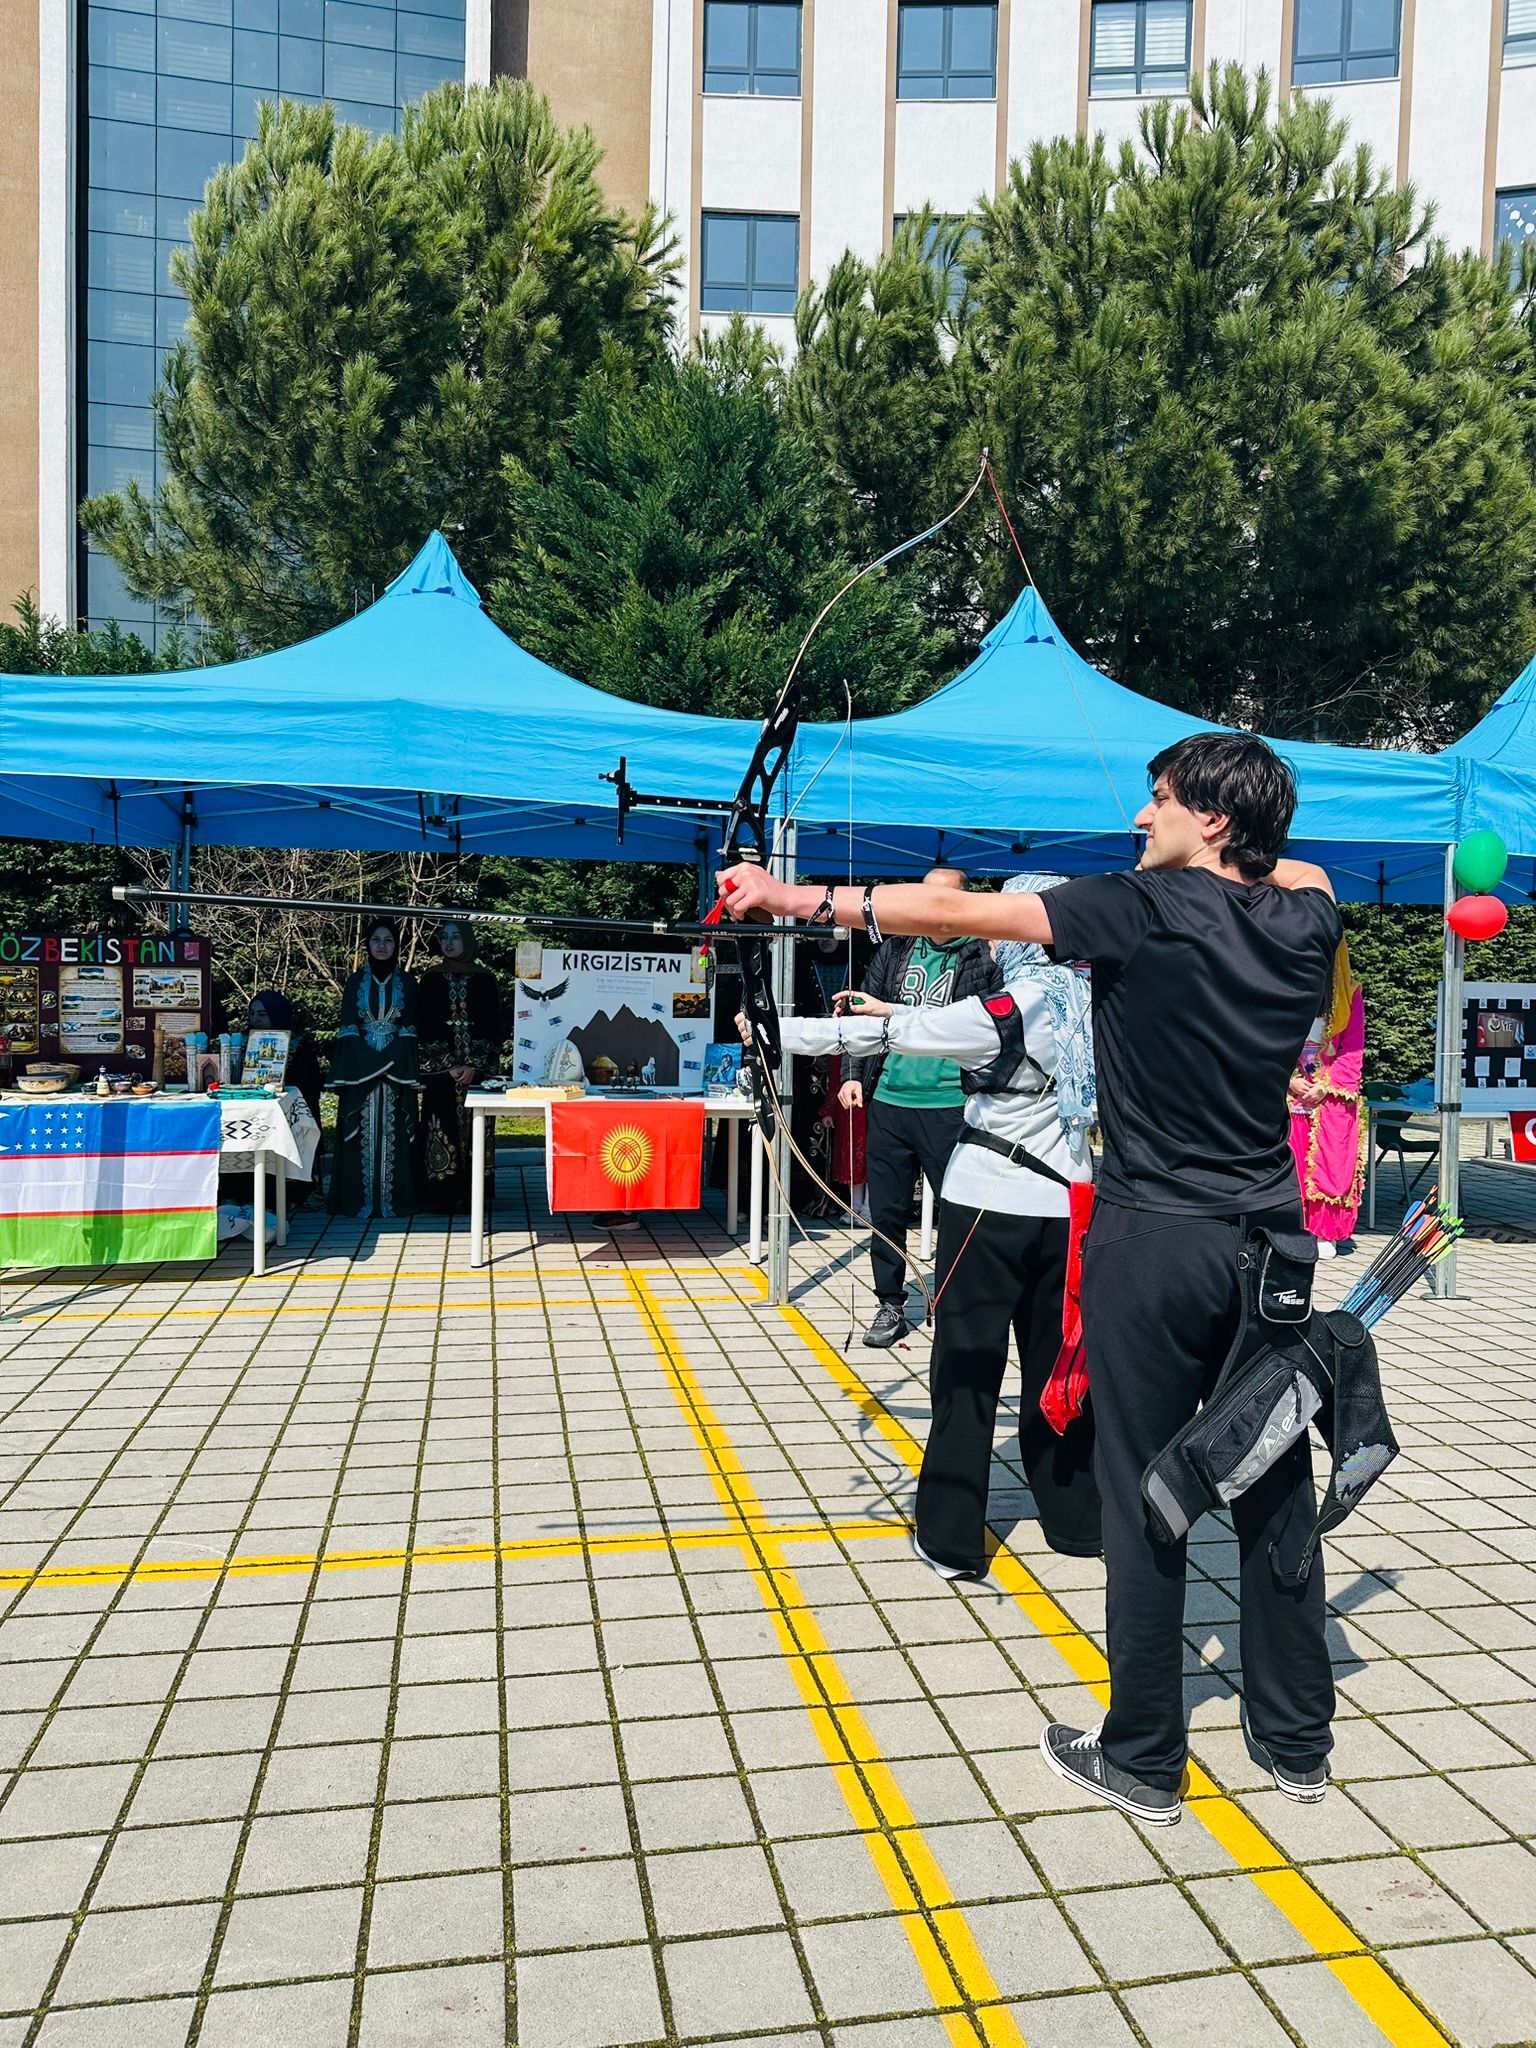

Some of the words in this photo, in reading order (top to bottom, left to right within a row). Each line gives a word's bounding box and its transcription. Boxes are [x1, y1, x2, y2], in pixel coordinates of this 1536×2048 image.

[0, 932, 176, 963] ÖZBEKİSTAN
[562, 953, 682, 973] KIRGIZİSTAN
[898, 964, 955, 1008] 84
